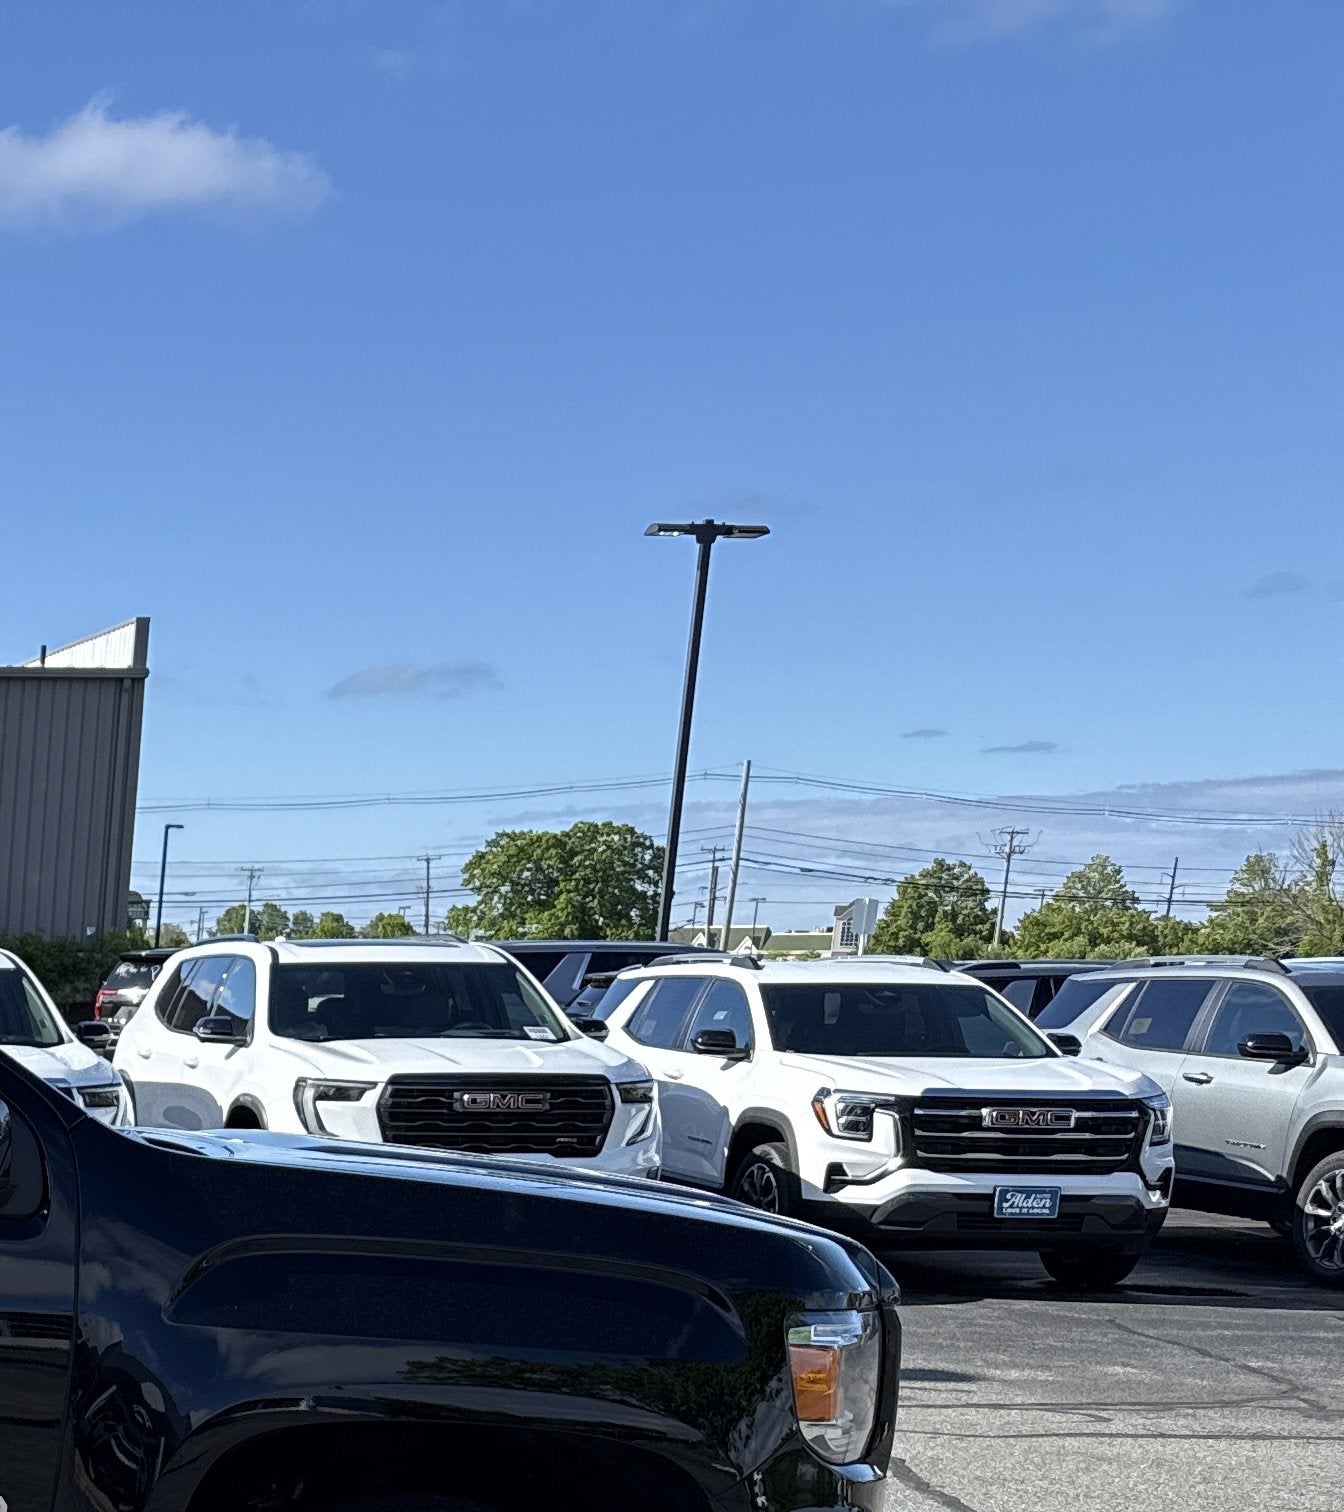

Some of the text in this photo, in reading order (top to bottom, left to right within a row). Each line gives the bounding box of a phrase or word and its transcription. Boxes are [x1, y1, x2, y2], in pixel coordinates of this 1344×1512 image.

[463, 1093, 544, 1109] GMC
[992, 1110, 1072, 1126] GMC
[1002, 1191, 1052, 1208] Alden
